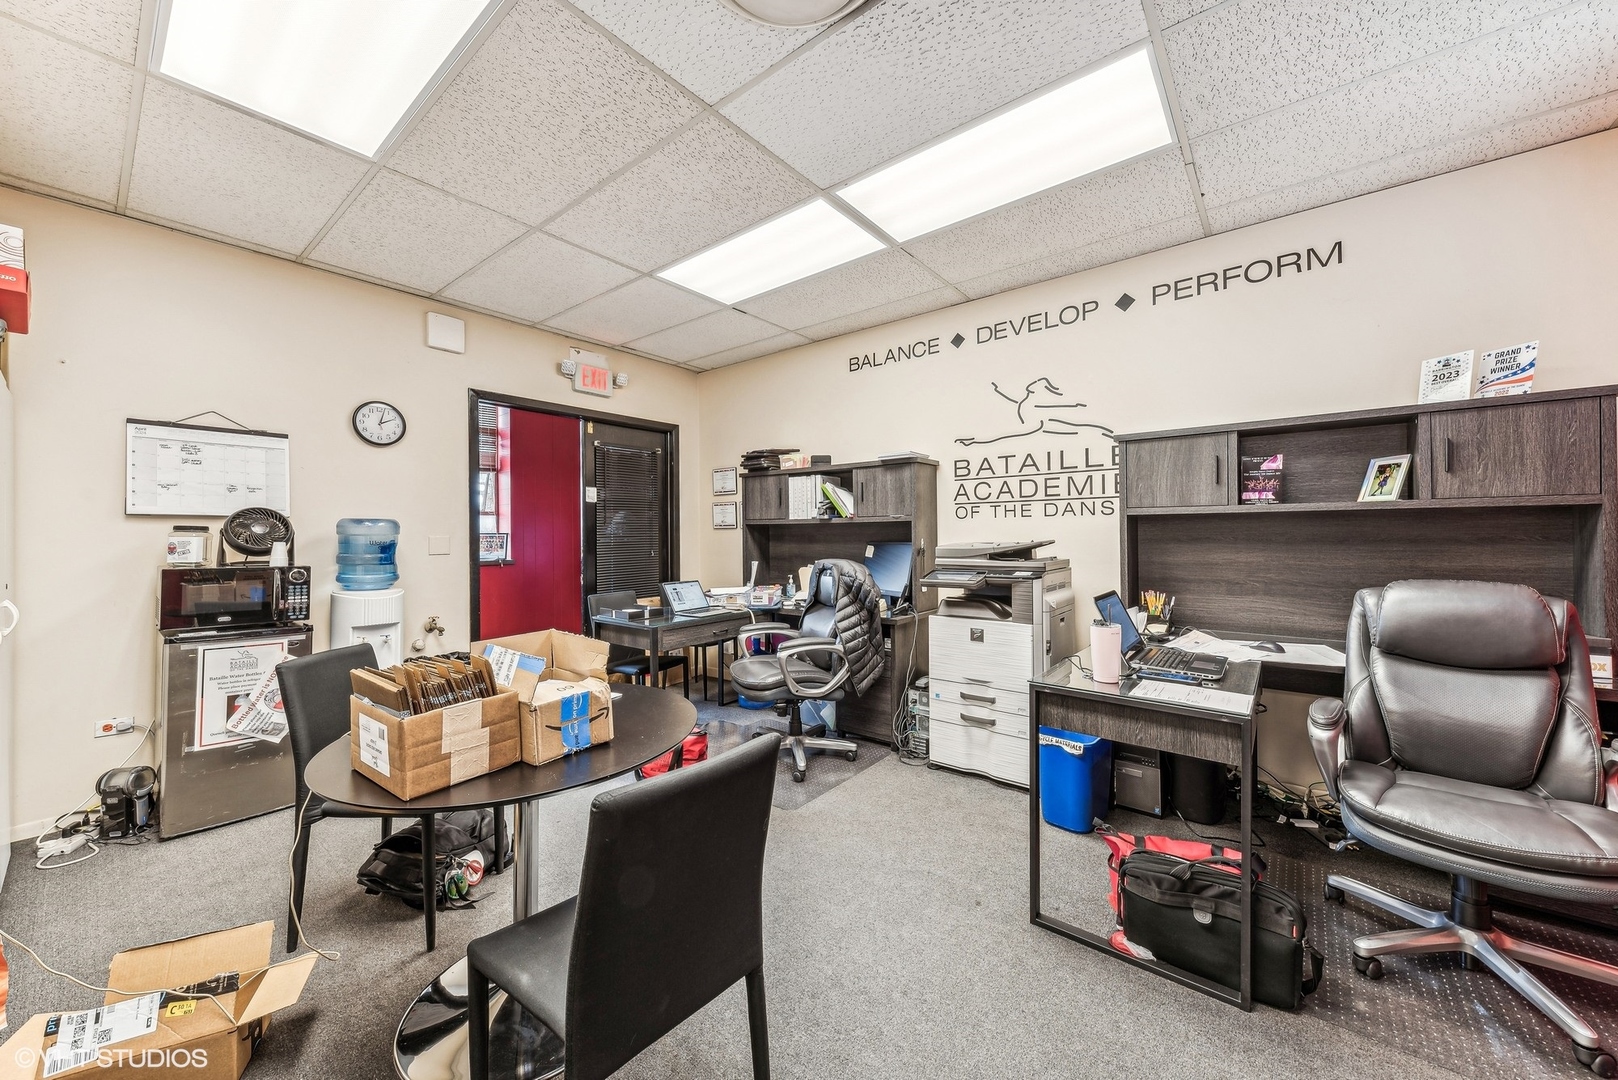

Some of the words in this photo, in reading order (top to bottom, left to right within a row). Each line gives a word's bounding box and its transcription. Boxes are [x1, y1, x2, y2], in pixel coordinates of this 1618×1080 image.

[849, 337, 940, 372] BALANCE
[976, 300, 1099, 345] DEVELOP
[1151, 241, 1343, 306] PERFORM
[1494, 347, 1521, 359] GRAND
[1495, 355, 1518, 366] PRIZE
[1490, 363, 1521, 375] WINNER
[580, 363, 609, 391] EXIT
[1431, 370, 1460, 382] 2023
[955, 505, 980, 519] OF
[990, 504, 1032, 518] THE
[1044, 500, 1115, 517] DANS
[231, 706, 254, 729] Bottled
[250, 689, 267, 708] Water
[262, 683, 270, 691] is
[170, 1005, 177, 1015] C
